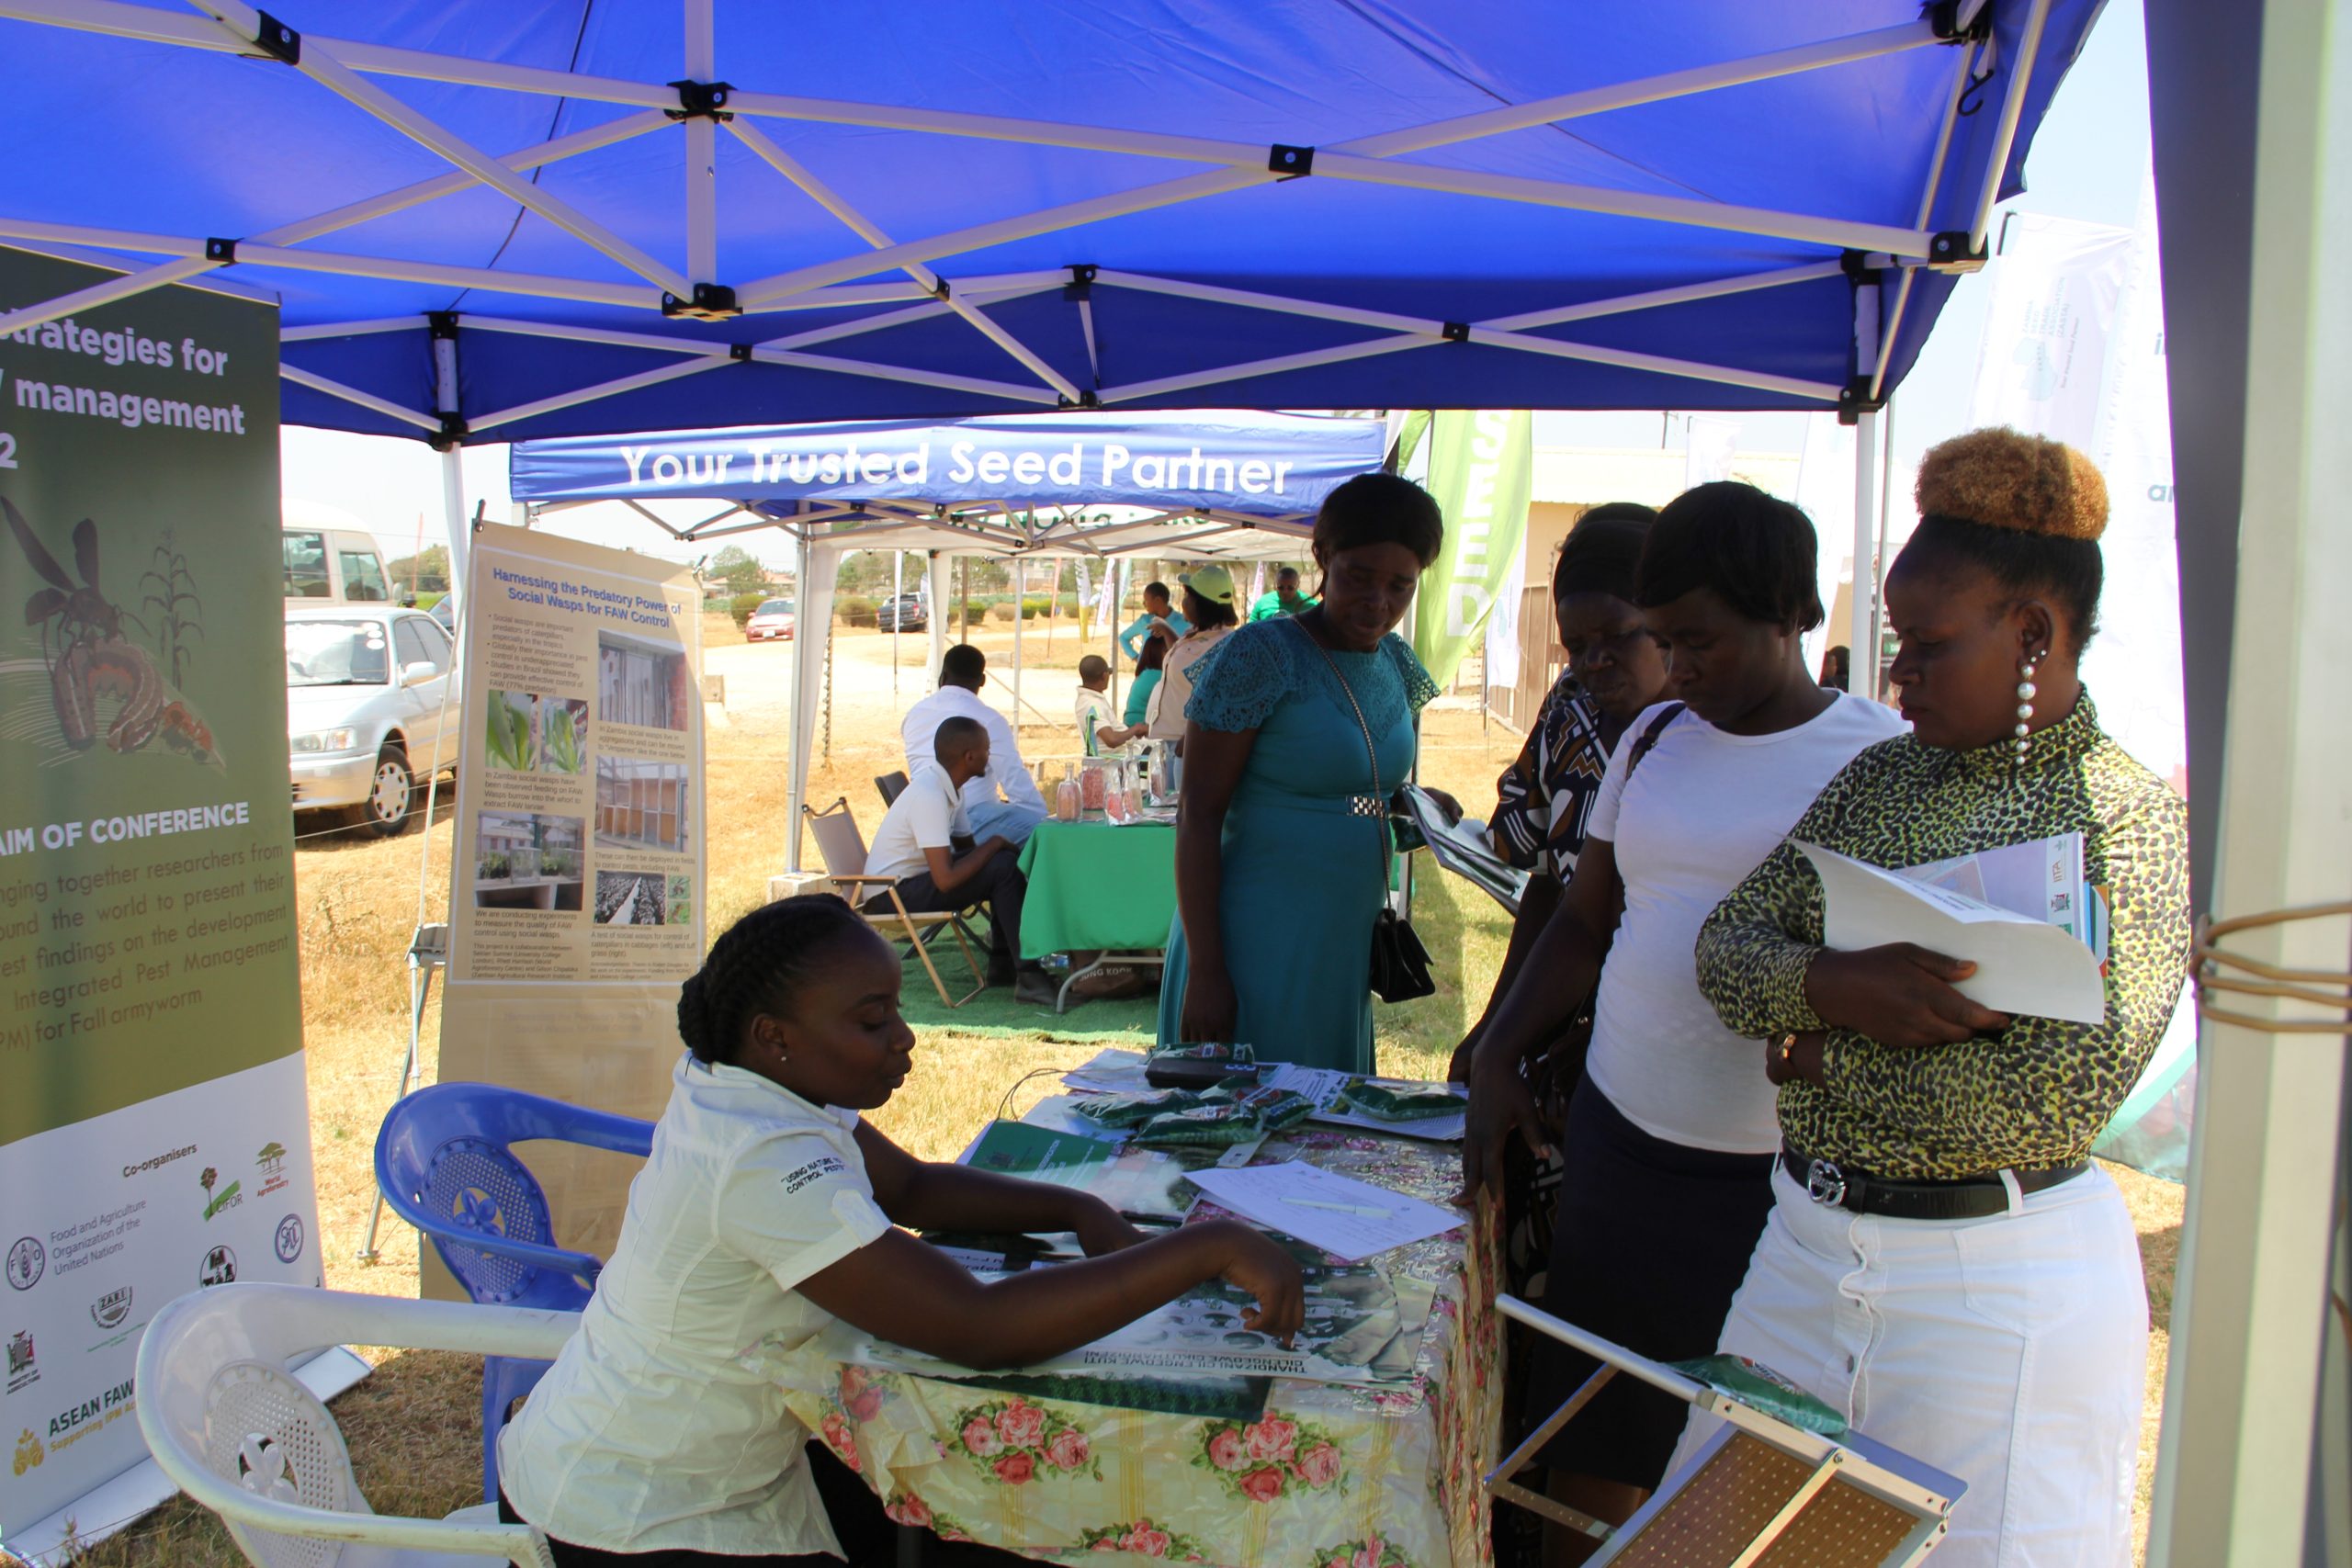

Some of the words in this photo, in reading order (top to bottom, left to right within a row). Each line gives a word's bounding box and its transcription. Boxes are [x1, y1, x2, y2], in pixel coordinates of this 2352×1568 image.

[0, 308, 175, 366] trategies
[182, 338, 229, 376] for
[15, 378, 245, 434] management
[619, 446, 733, 486] Your
[748, 442, 929, 485] Trusted
[948, 441, 1082, 486] Seed
[1102, 444, 1294, 494] Partner
[1447, 410, 1511, 637] SEED
[492, 567, 558, 593] Harnessing
[561, 582, 578, 595] the
[582, 585, 633, 608] Predatory
[636, 598, 667, 612] Power
[671, 604, 681, 615] of
[508, 587, 544, 604] Social
[547, 594, 583, 612] Wasps
[586, 602, 602, 615] for
[605, 605, 628, 620] FAW
[630, 611, 670, 628] Control
[42, 822, 83, 850] OF
[90, 801, 250, 844] CONFERENCE
[56, 864, 140, 899] together
[147, 850, 245, 879] researchers
[251, 842, 284, 863] from
[51, 908, 84, 931] the
[96, 894, 147, 921] world
[157, 894, 175, 910] to
[184, 880, 245, 911] present
[253, 873, 286, 894] their
[2, 955, 27, 977] est
[36, 939, 115, 970] findings
[123, 934, 143, 953] on
[152, 926, 177, 946] the
[186, 904, 287, 941] development
[14, 971, 122, 1011] Integrated
[136, 961, 171, 984] Pest
[185, 934, 288, 972] Management
[35, 1020, 65, 1043] for
[71, 1007, 106, 1035] Fall
[110, 987, 203, 1025] armyworm
[122, 1144, 198, 1179] Co-organisers
[786, 1167, 808, 1182] USING
[786, 1170, 823, 1194] CONTROL
[50, 1224, 77, 1243] Food
[79, 1217, 97, 1235] and
[99, 1200, 146, 1226] Agriculture
[216, 1193, 243, 1213] CIFOR
[52, 1227, 115, 1259] Organization
[116, 1223, 125, 1235] of
[126, 1217, 141, 1231] the
[54, 1253, 88, 1276] United
[91, 1241, 124, 1263] Nations
[50, 1396, 100, 1437] ASEAN
[104, 1378, 134, 1408] FAW
[51, 1419, 103, 1452] Supporting
